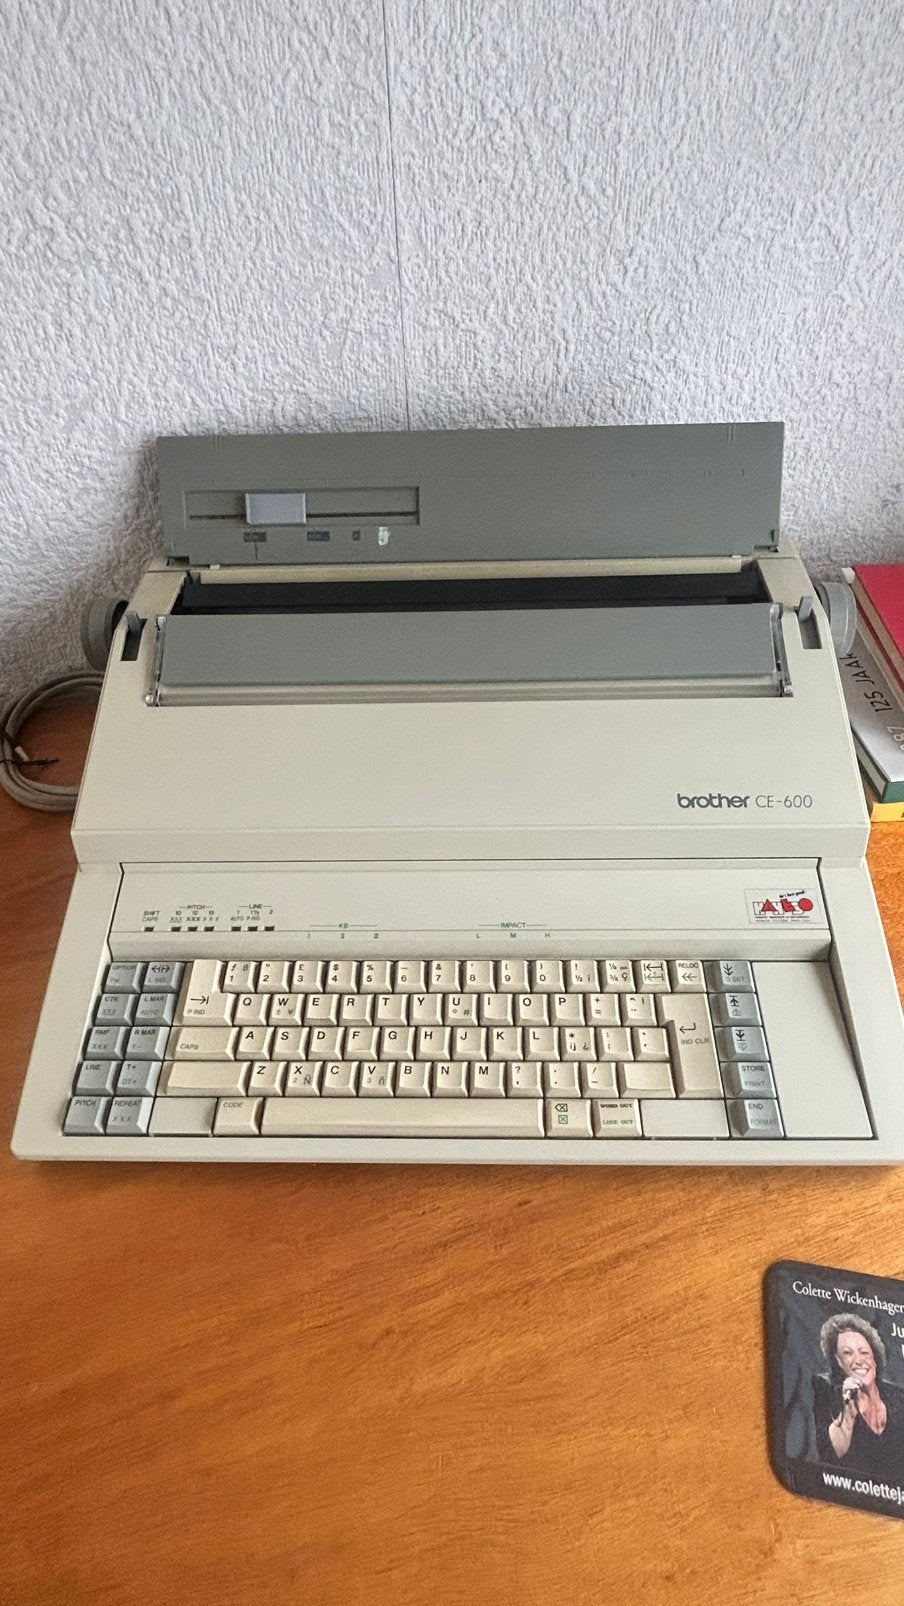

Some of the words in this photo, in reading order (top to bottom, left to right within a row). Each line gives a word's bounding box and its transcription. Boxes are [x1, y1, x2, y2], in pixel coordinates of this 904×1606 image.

[864, 691, 893, 712] 125
[677, 793, 750, 808] brother
[755, 795, 813, 808] CE-600
[333, 963, 339, 971] $
[435, 963, 442, 971] &
[469, 974, 476, 982] 8
[504, 974, 511, 982] 9
[539, 974, 546, 982] 0
[242, 998, 252, 1006] Q
[278, 998, 289, 1006] W
[312, 998, 320, 1006] E
[347, 998, 355, 1006] R
[382, 998, 390, 1006] T
[417, 997, 425, 1006] Y
[452, 998, 460, 1006] U
[487, 997, 491, 1006] I
[523, 998, 532, 1006] O
[558, 997, 566, 1006] P
[245, 1031, 254, 1040] A
[281, 1031, 289, 1040] S
[317, 1031, 325, 1040] D
[352, 1031, 360, 1040] F
[388, 1031, 397, 1040] G
[424, 1031, 433, 1040] H
[460, 1031, 467, 1040] J
[496, 1031, 504, 1040] K
[533, 1031, 540, 1040] L
[257, 1066, 266, 1074] Z
[293, 1066, 302, 1074] X
[330, 1066, 339, 1075] C
[368, 1066, 376, 1074] V
[404, 1066, 412, 1074] B
[441, 1066, 449, 1075] N
[478, 1066, 489, 1075] M
[792, 1281, 832, 1299] Colette
